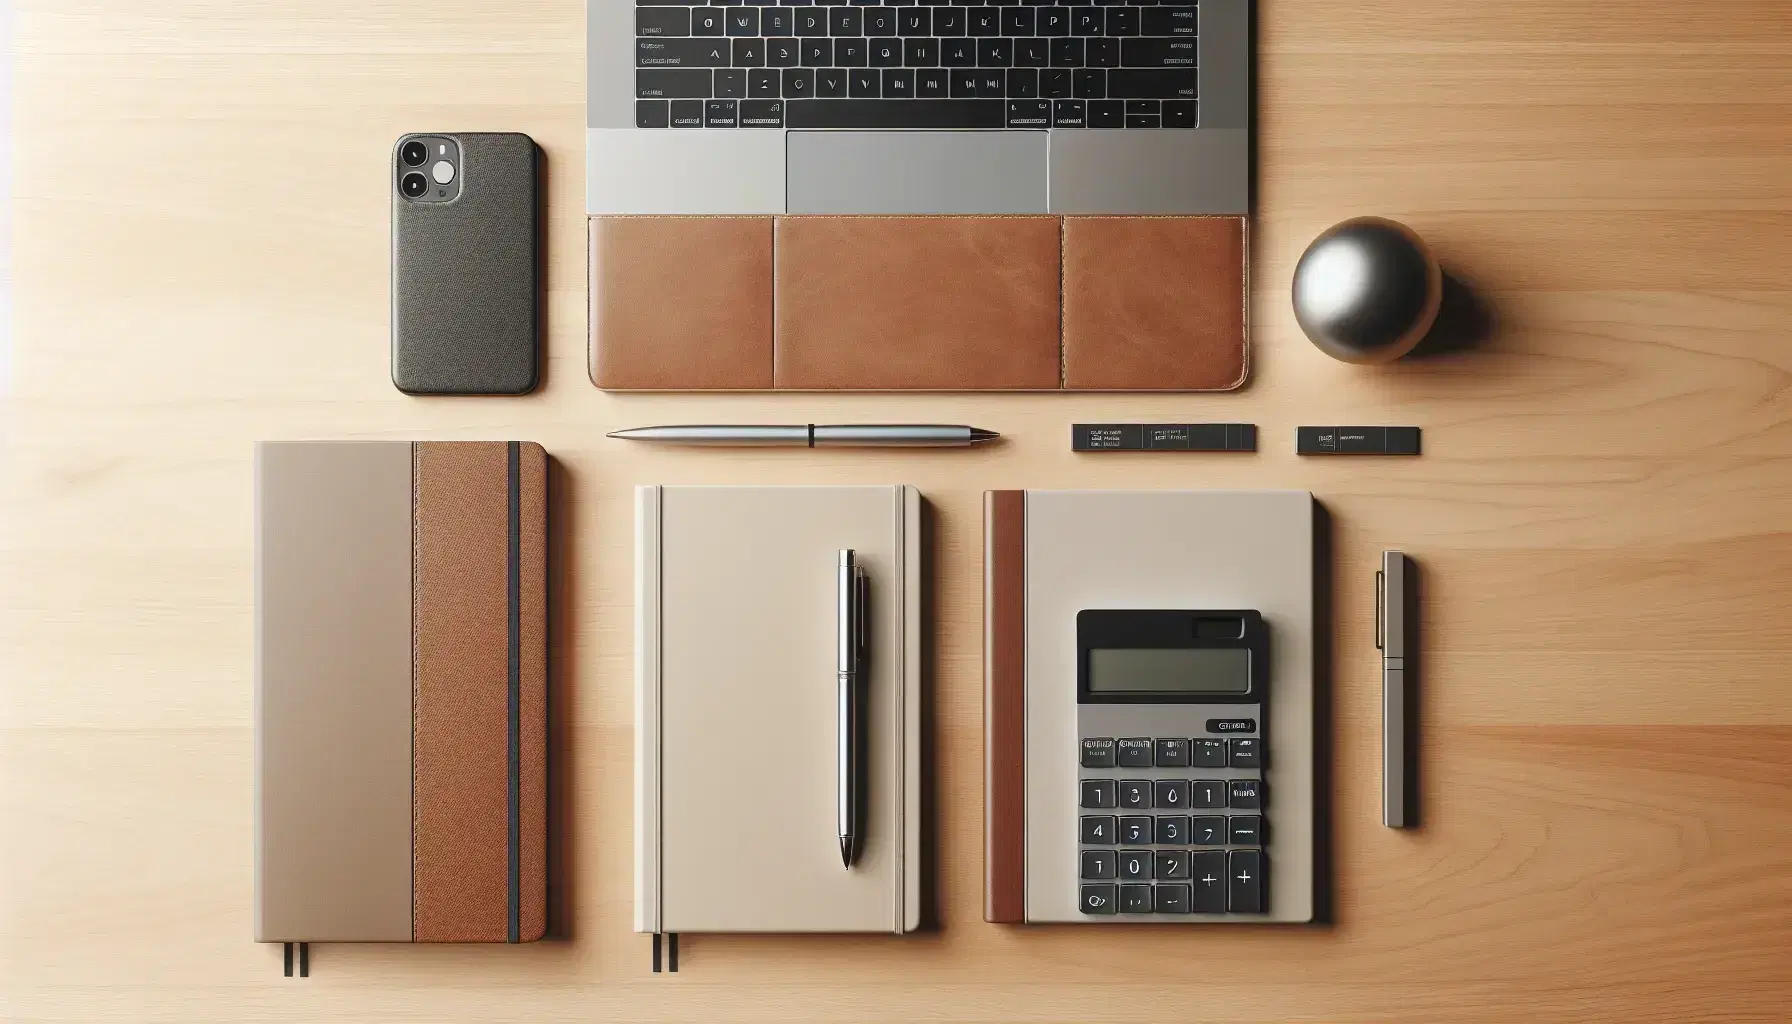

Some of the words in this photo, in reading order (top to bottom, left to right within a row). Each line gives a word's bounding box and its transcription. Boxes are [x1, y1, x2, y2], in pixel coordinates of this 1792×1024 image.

[1015, 17, 1024, 27] L
[827, 79, 837, 90] V
[1206, 788, 1212, 803] 1
[1093, 824, 1103, 837] 4
[1129, 859, 1140, 874] 0
